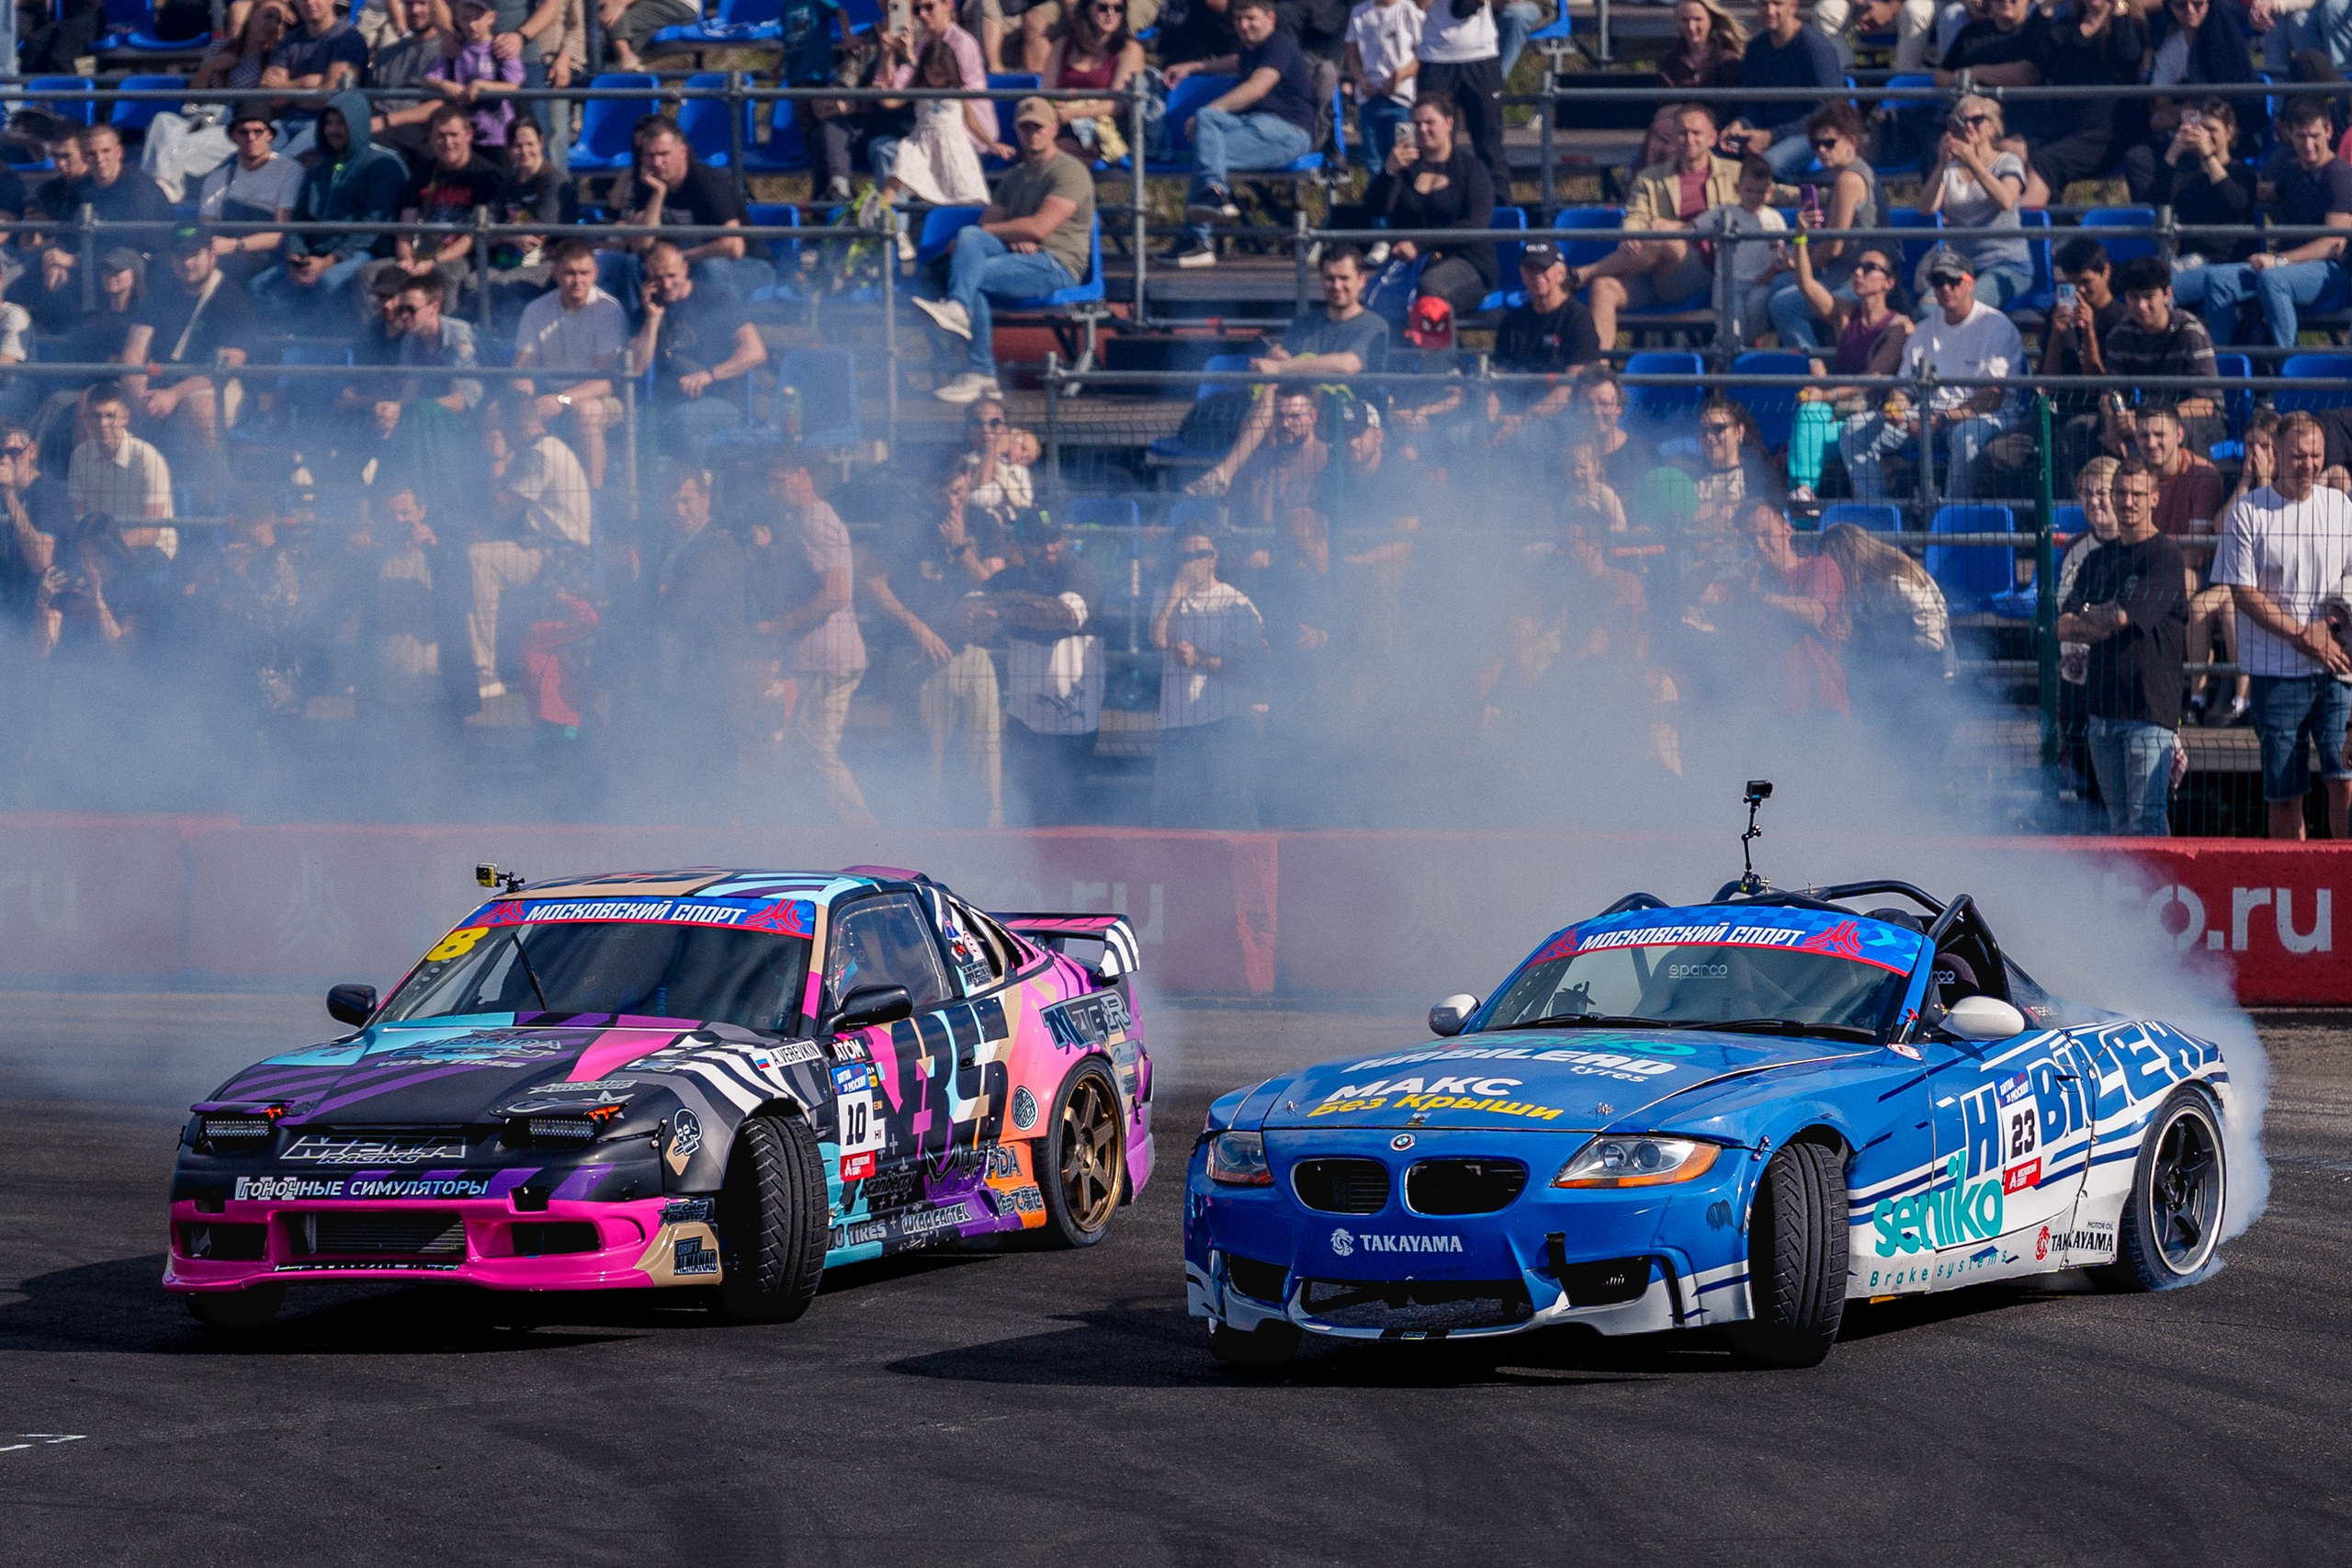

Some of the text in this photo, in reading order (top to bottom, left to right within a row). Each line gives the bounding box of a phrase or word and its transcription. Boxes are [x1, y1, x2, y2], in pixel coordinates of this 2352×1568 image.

[525, 899, 748, 925] МОСКОВСКИЙ СПОРТ
[426, 927, 489, 962] 8
[1577, 922, 1806, 952] МОСКОВСКИЙ СПОРТ
[1668, 964, 1728, 979] sparco
[448, 1059, 526, 1068] TIRES
[832, 1039, 865, 1062] ATOM
[1340, 1048, 1677, 1075] HABILEAD
[1570, 1065, 1649, 1083] tyres
[1325, 1076, 1523, 1103] МАКС
[1306, 1093, 1565, 1121] Без Крыши
[846, 1102, 866, 1146] 10
[2010, 1108, 2036, 1159] 23
[316, 1152, 424, 1165] RACING
[236, 1178, 490, 1199] ГОНОЧНЫЕ СИМУЛЯТОРЫ
[1872, 1150, 2004, 1258] seniko
[847, 1218, 888, 1245] TIRES
[2087, 1221, 2105, 1230] MOTOR
[677, 1241, 699, 1256] DRIFT
[1360, 1235, 1464, 1252] TAKAYAMA
[2051, 1230, 2113, 1253] TAKAYAMA
[1870, 1249, 2007, 1287] Brake systems
